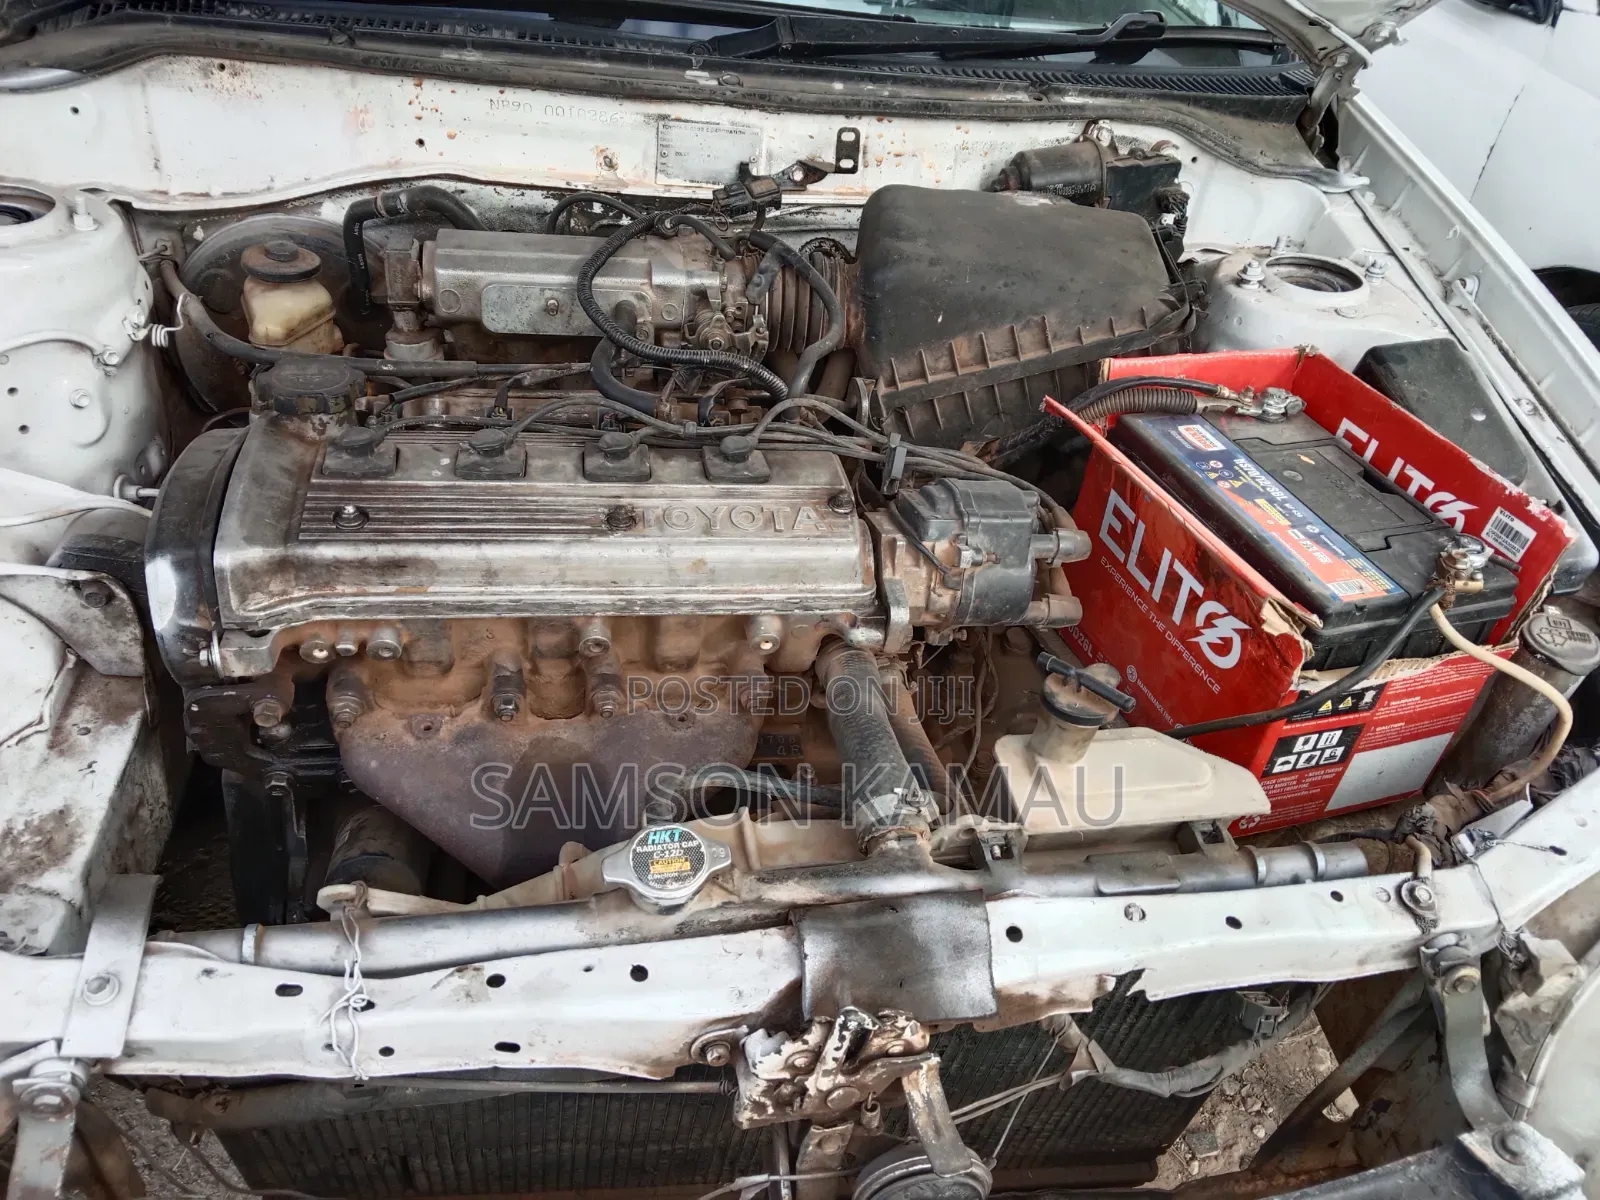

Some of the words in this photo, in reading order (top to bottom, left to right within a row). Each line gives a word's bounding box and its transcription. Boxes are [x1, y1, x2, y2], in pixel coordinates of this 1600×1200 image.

[640, 504, 827, 532] TOYOTA
[1100, 555, 1149, 613] EXPERIENCE
[1149, 611, 1166, 633] THE
[1165, 630, 1222, 695] DIFFERENCE
[1068, 625, 1093, 659] 0D26L
[636, 842, 680, 853] RADIATOR
[681, 840, 699, 848] CAP
[647, 828, 683, 845] HKT
